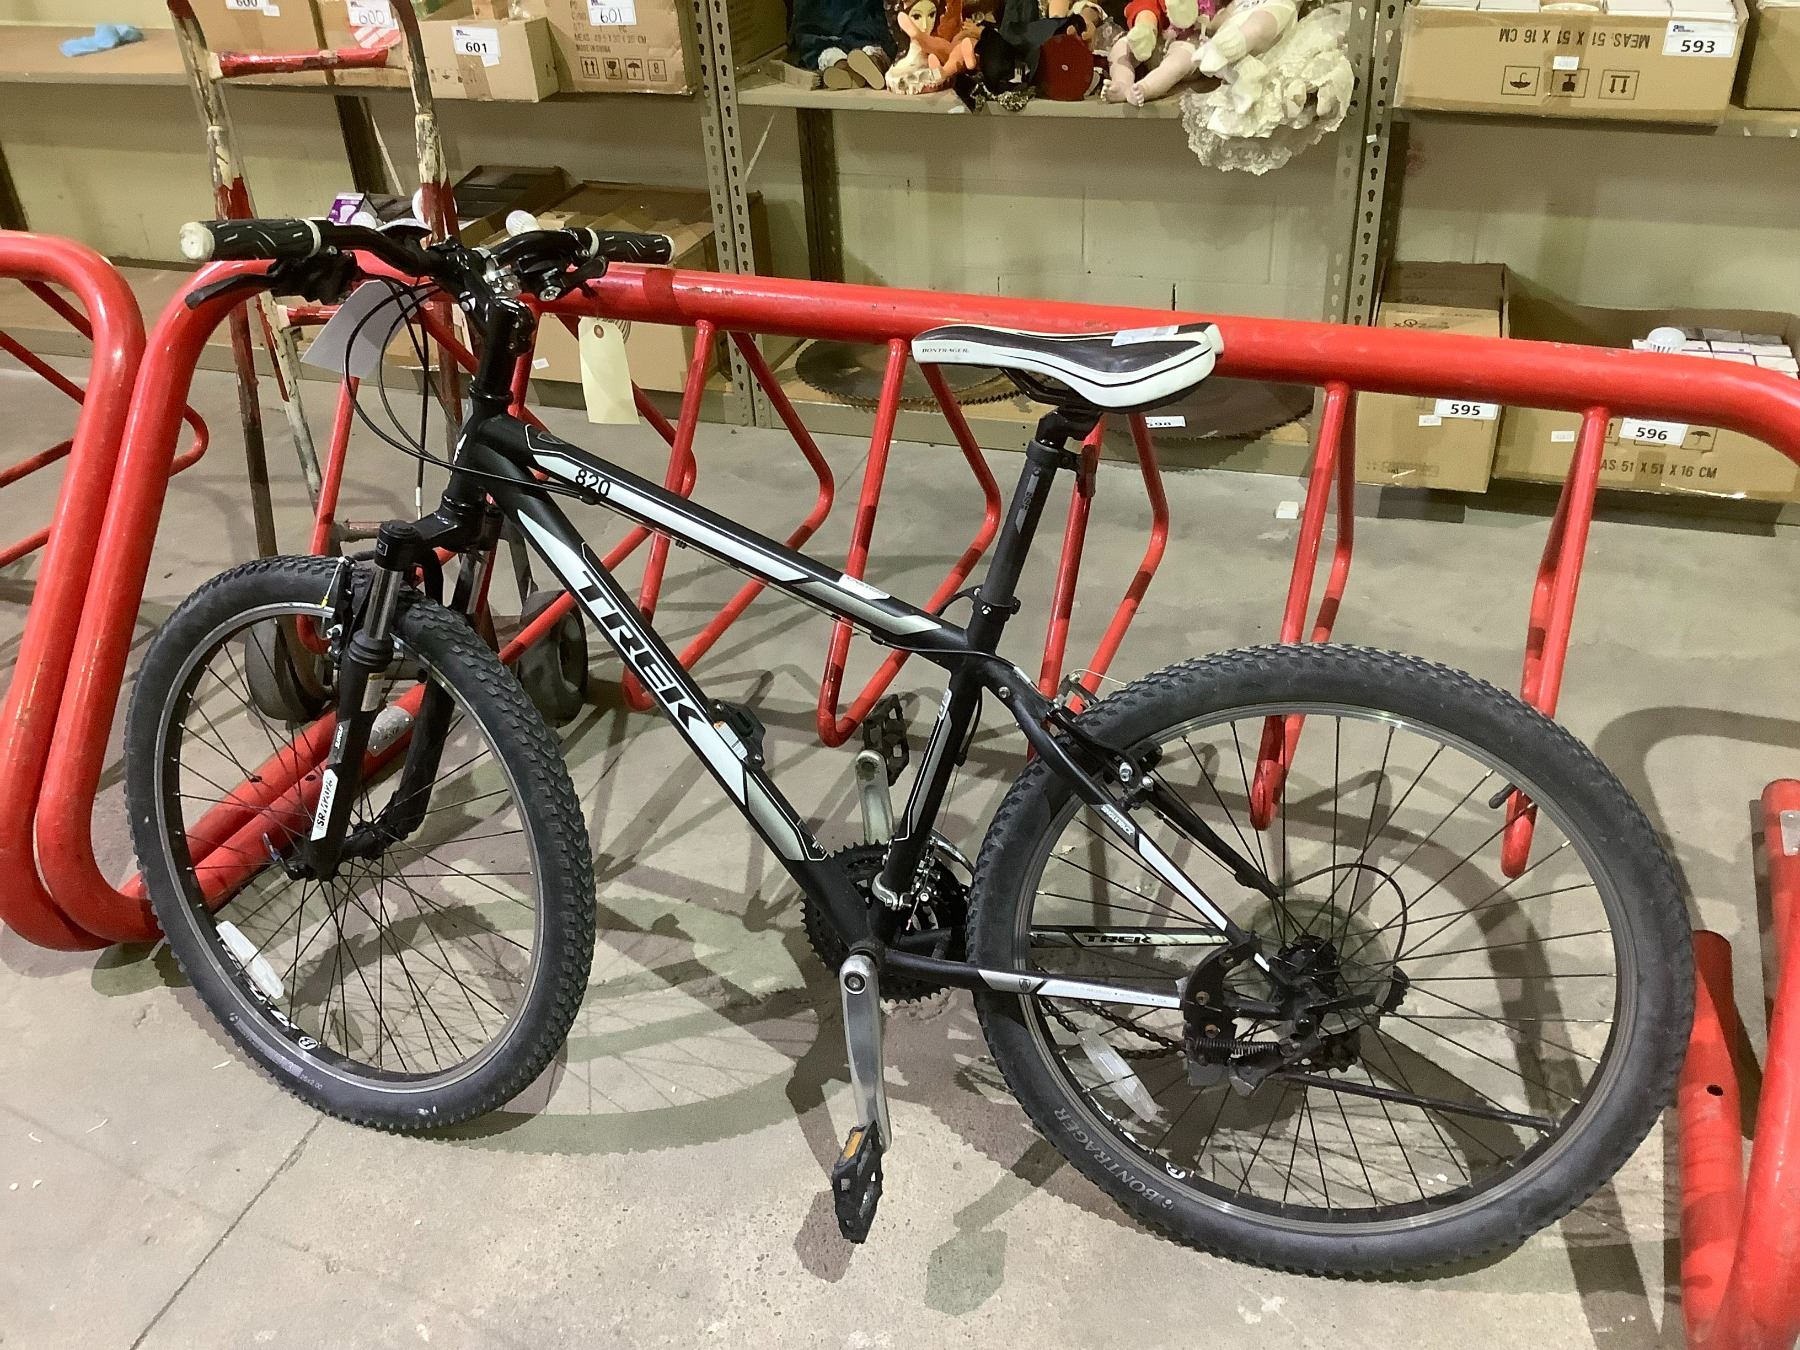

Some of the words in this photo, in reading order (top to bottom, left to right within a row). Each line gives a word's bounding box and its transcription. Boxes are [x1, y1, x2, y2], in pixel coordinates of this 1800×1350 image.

[358, 9, 385, 25] 600
[600, 8, 622, 23] 601
[1499, 27, 1518, 43] CM
[1523, 29, 1537, 44] 16
[1542, 29, 1550, 44] X
[1557, 29, 1571, 45] 51
[1576, 31, 1585, 46] X
[1591, 31, 1606, 46] 51
[465, 41, 487, 53] 601
[1680, 39, 1716, 53] 593
[1450, 403, 1481, 416] 595
[1635, 427, 1668, 440] 596
[1600, 459, 1617, 471] AS
[1621, 460, 1634, 472] 51
[1640, 462, 1648, 473] X
[1650, 462, 1664, 474] 51
[1669, 464, 1677, 476] X
[1681, 465, 1694, 477] 16
[1699, 466, 1717, 479] CM
[574, 469, 611, 497] 820
[578, 570, 707, 730] TREK
[1083, 935, 1152, 944] TREK
[1054, 1107, 1161, 1201] BONTRAGER
